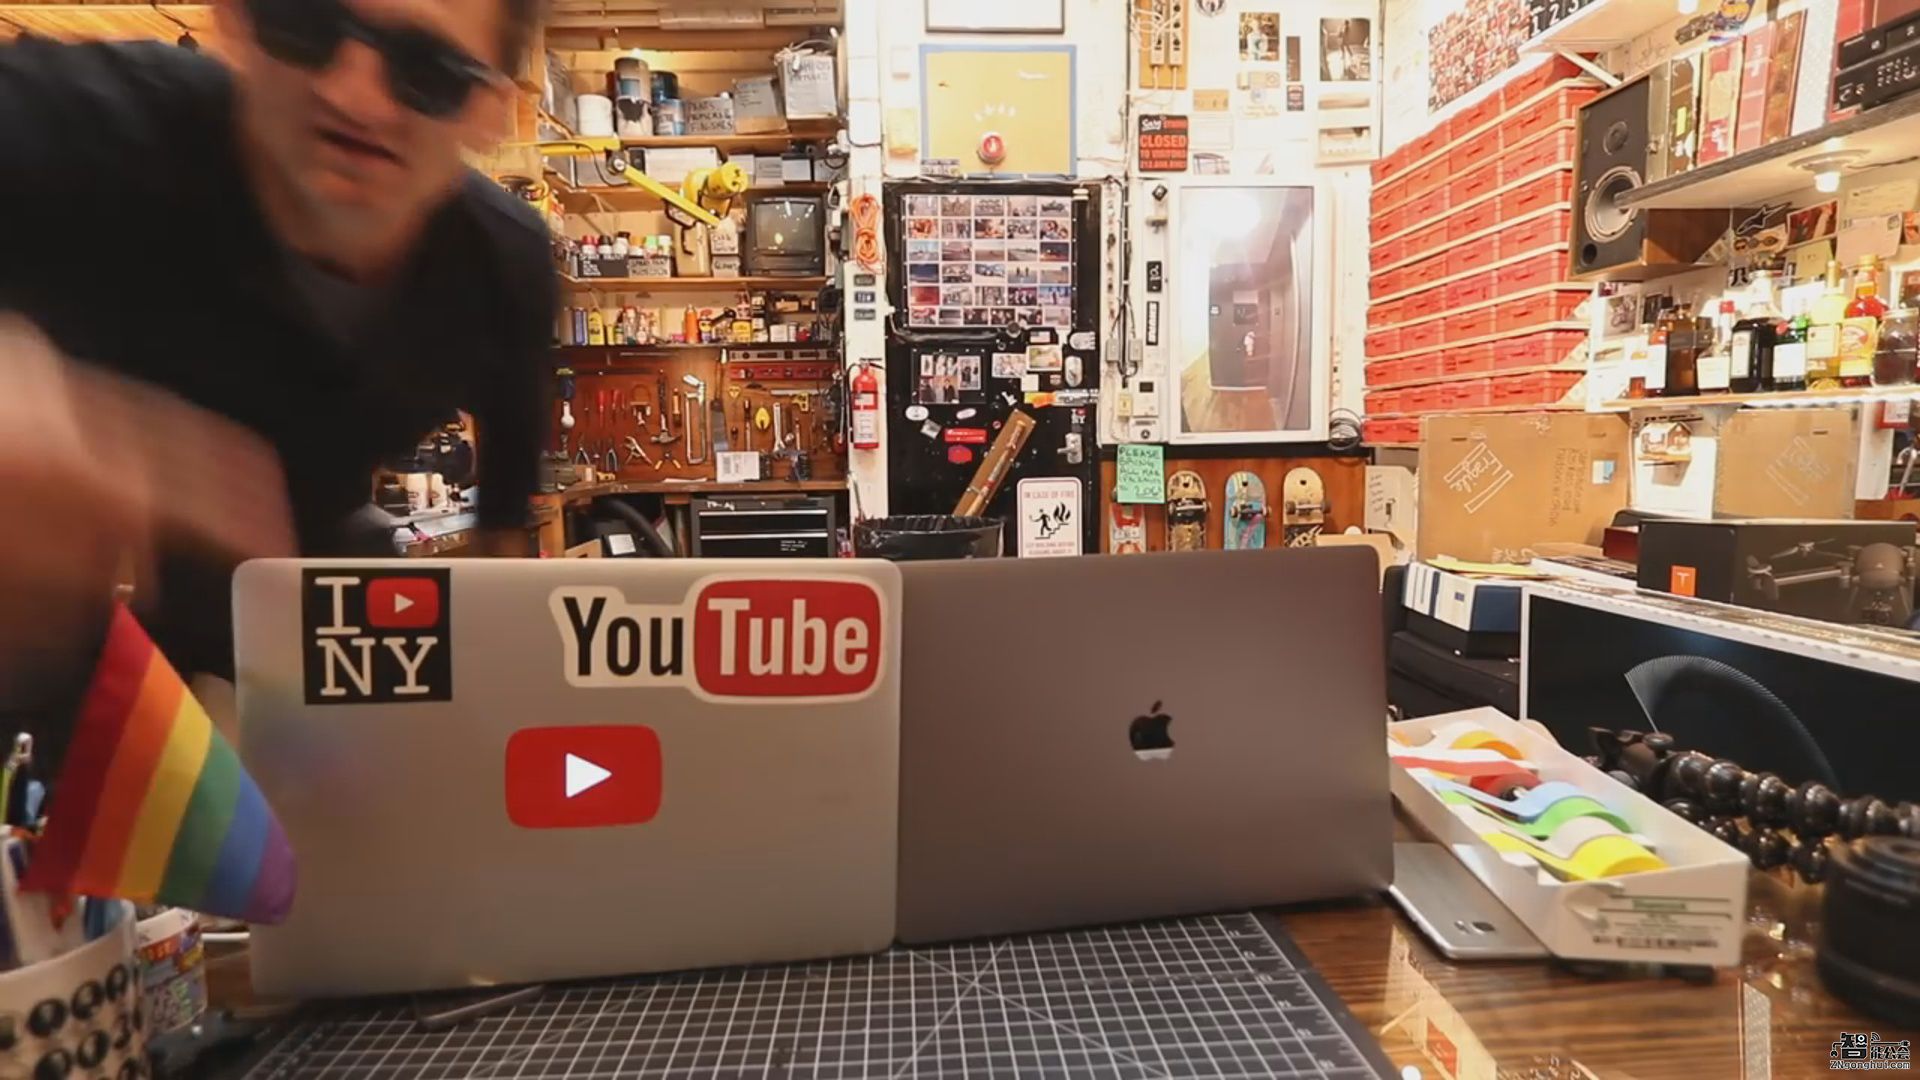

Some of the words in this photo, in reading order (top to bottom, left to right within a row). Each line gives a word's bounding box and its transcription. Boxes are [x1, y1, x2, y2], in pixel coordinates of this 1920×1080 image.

[1531, 15, 1541, 37] 1
[1549, 3, 1560, 26] 2
[1140, 134, 1186, 148] CLOSED
[1119, 446, 1160, 459] PLEASE
[314, 576, 362, 635] I
[563, 597, 869, 677] YouTube
[316, 636, 439, 697] NY
